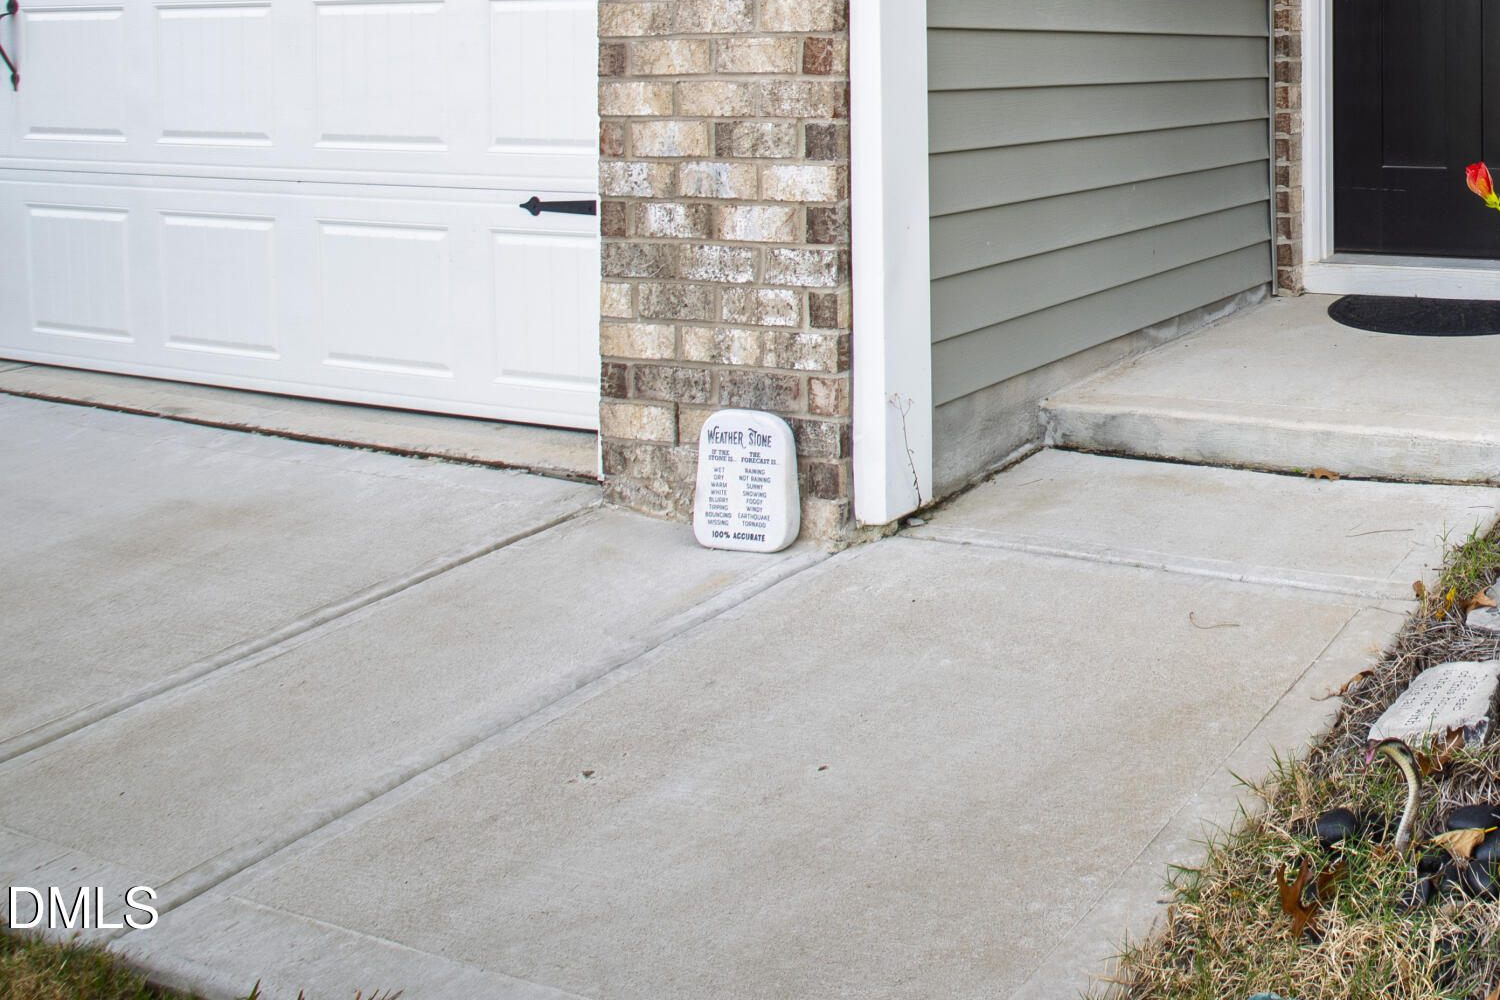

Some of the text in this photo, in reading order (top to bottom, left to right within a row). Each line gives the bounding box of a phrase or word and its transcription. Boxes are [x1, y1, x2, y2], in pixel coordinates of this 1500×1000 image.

[708, 426, 772, 449] WEATHER STONE
[750, 475, 771, 483] RAINING
[742, 490, 767, 498] SNOWING
[738, 512, 770, 521] EARTHQUAKE
[742, 520, 766, 528] TORNADO
[712, 530, 765, 542] 100% ACCURATE
